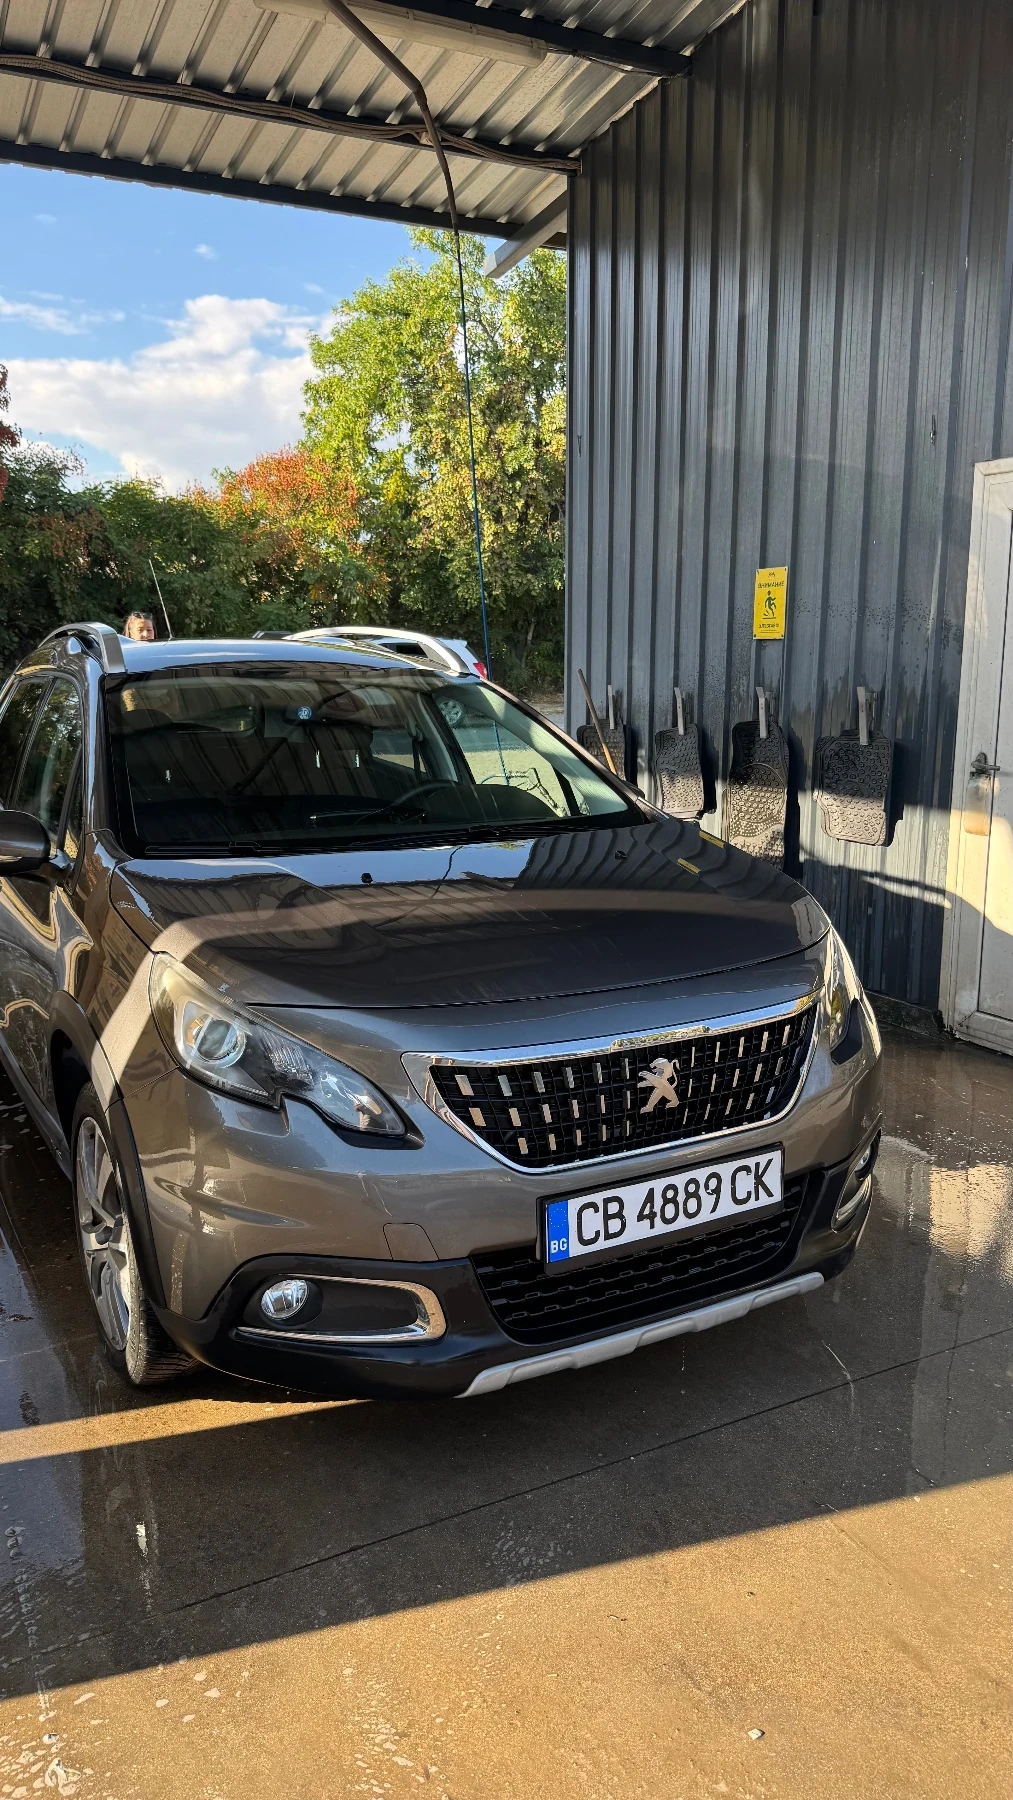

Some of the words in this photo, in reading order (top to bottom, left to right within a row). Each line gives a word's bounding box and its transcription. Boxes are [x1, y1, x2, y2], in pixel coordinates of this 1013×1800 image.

[577, 1195, 627, 1246] CB
[637, 1172, 722, 1229] 4889
[731, 1158, 774, 1205] CK
[551, 1238, 568, 1254] BG
